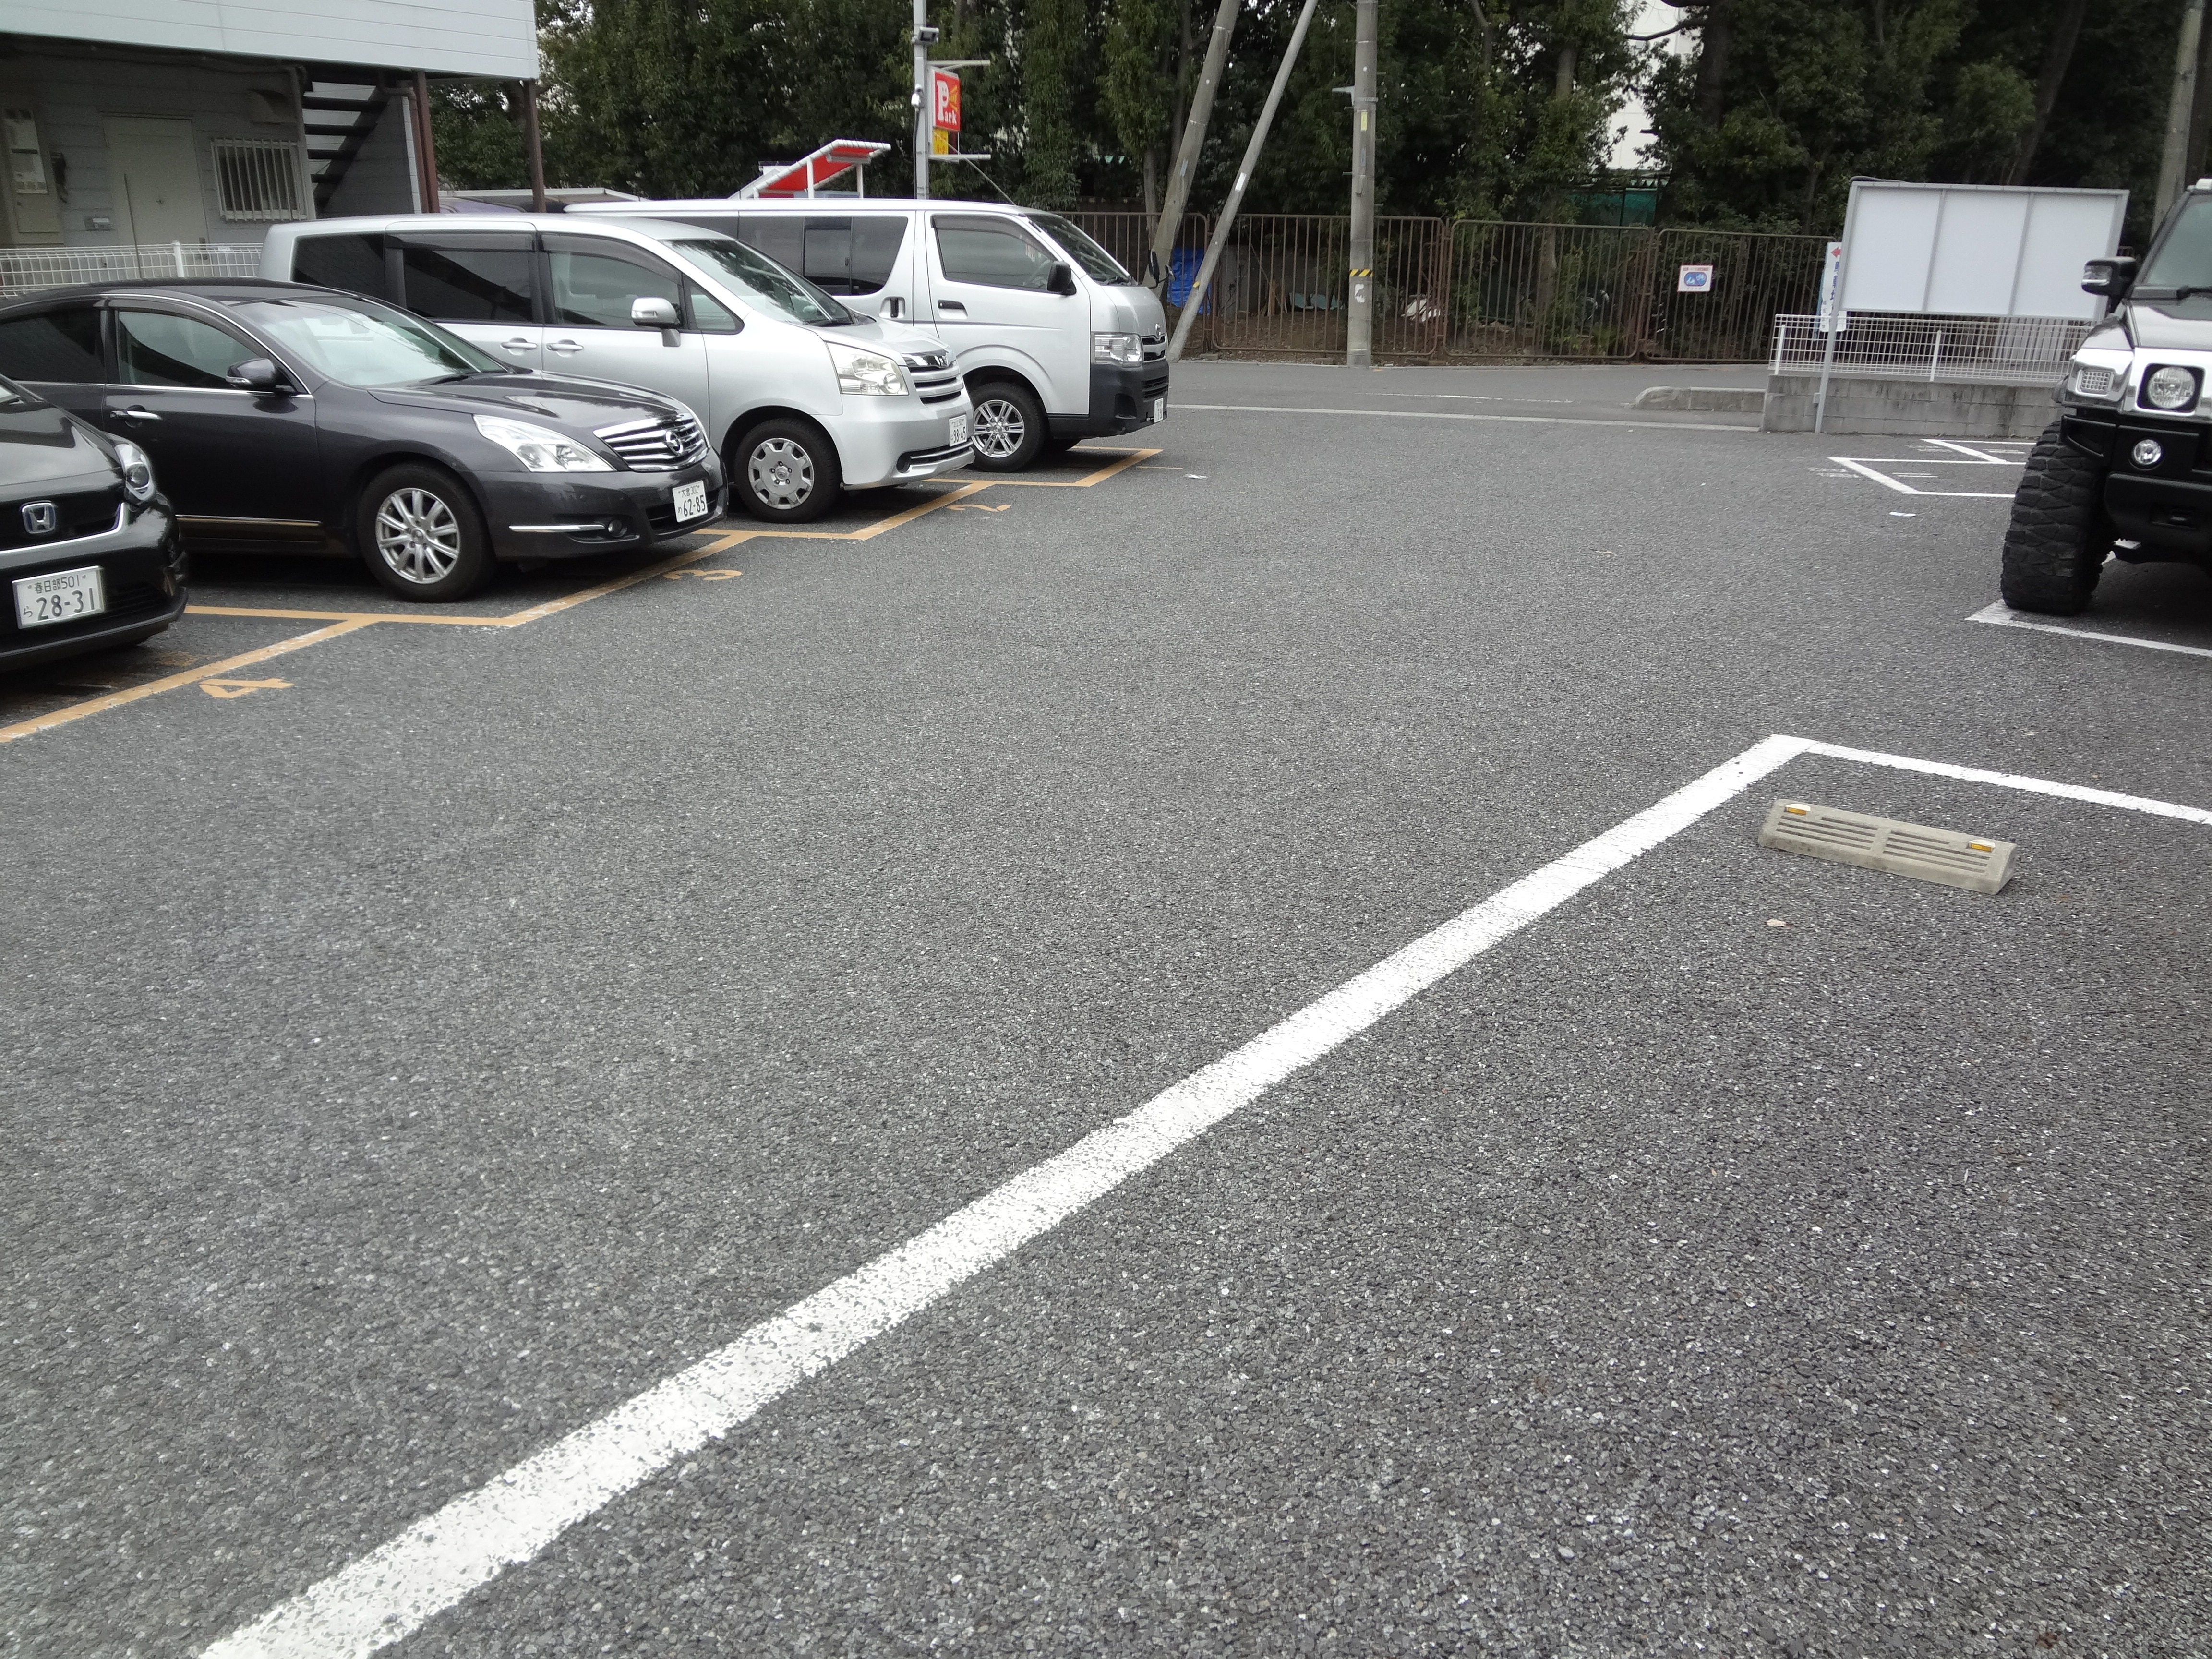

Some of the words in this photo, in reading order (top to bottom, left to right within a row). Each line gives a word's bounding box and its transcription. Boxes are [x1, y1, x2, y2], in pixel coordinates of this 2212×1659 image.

[937, 80, 957, 125] Park
[34, 575, 80, 594] 春日部501
[36, 587, 95, 621] 28-31
